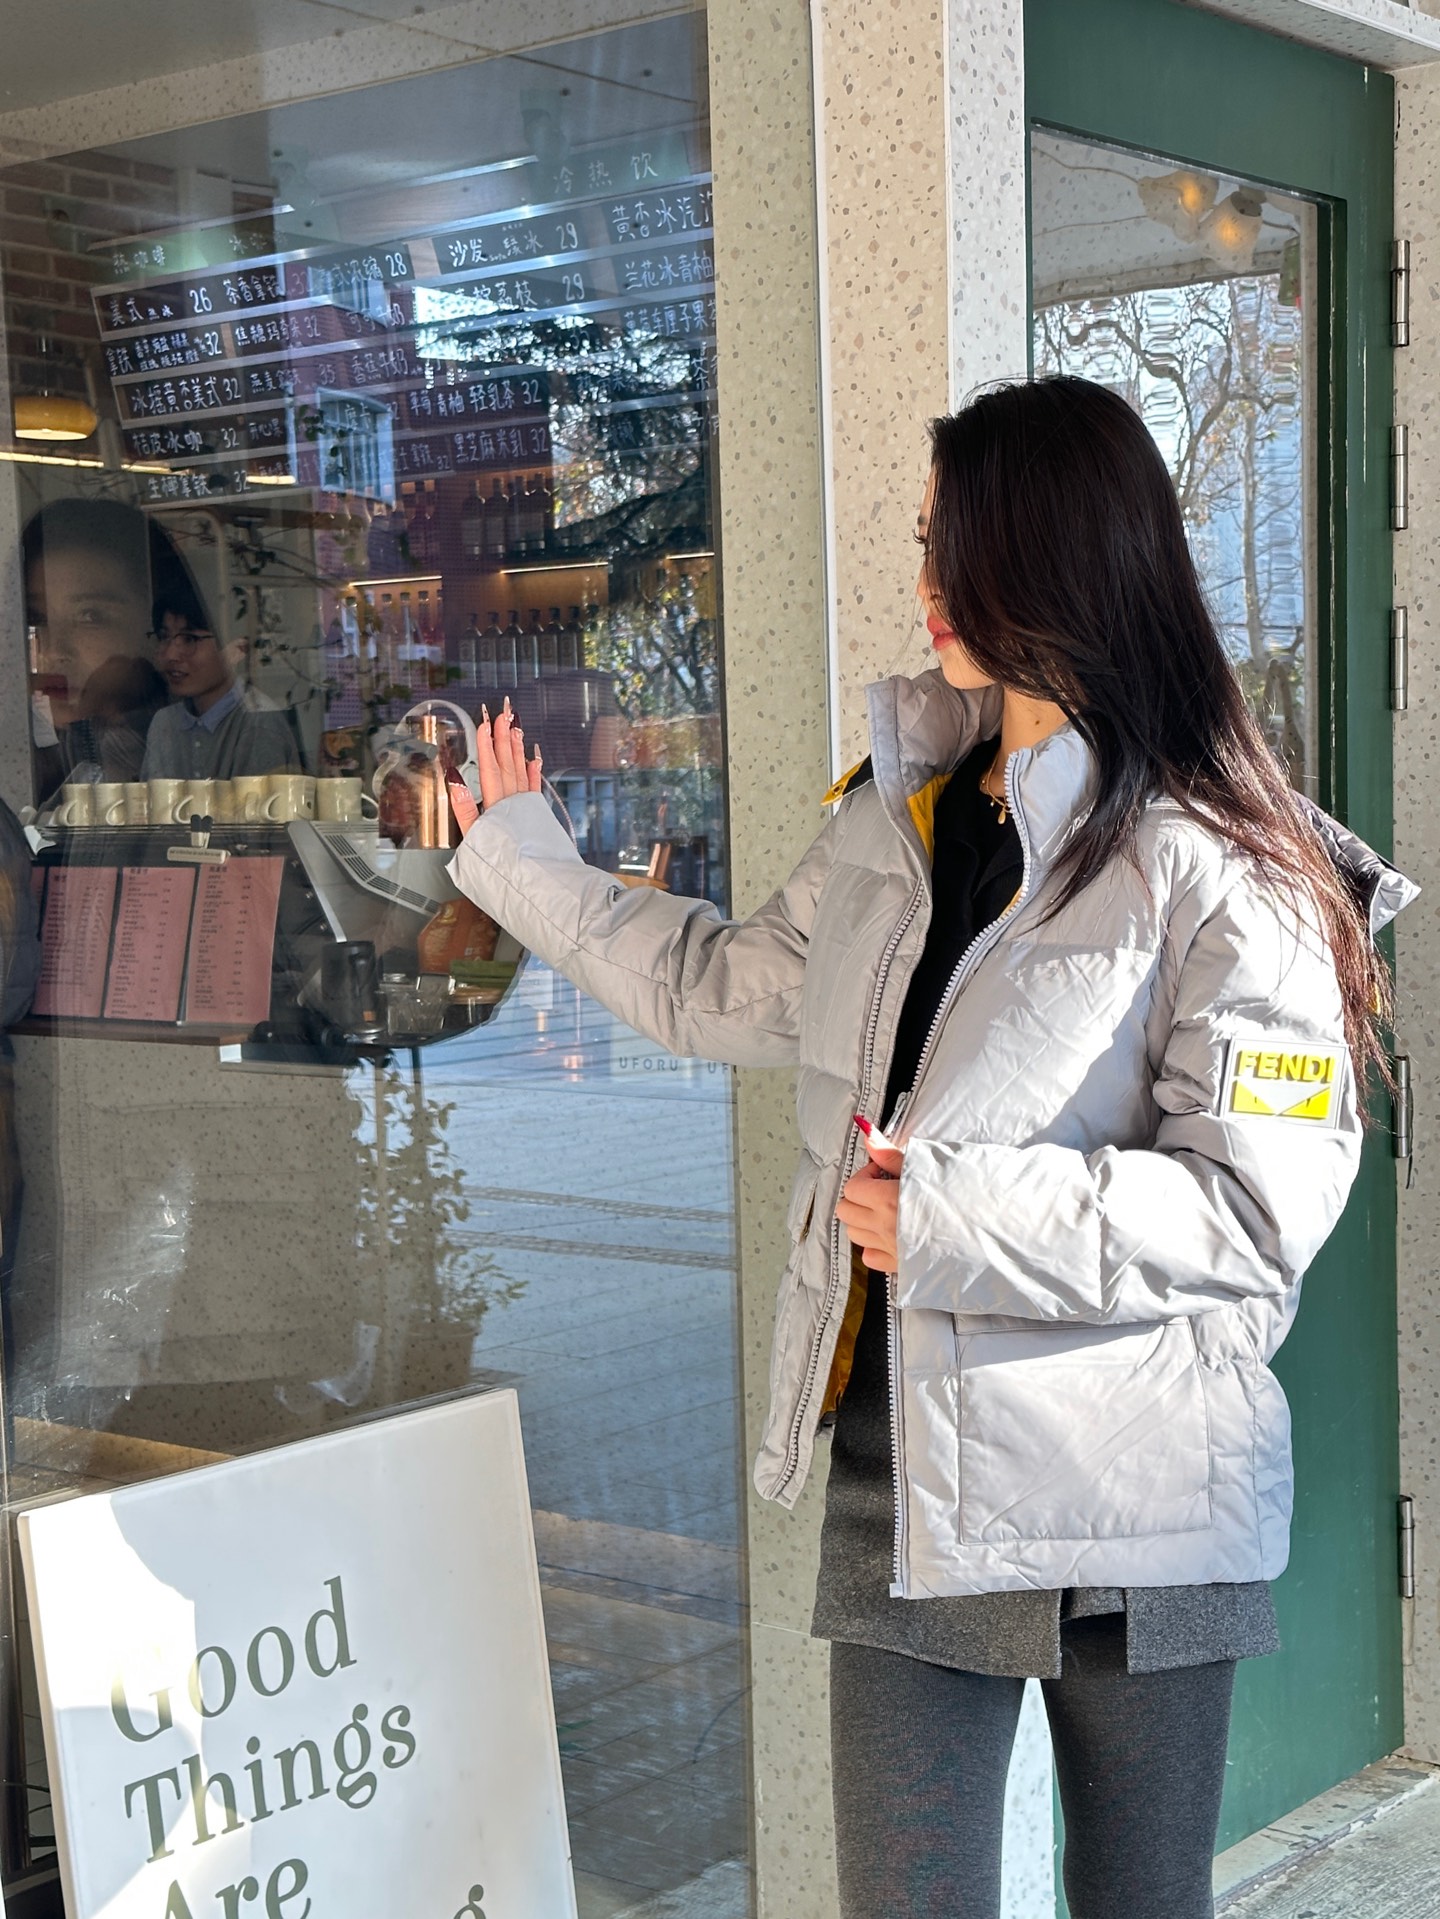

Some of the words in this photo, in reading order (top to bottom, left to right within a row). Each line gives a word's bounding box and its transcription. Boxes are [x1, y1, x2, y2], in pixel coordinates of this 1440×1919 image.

[552, 152, 658, 194] 冷热饮
[448, 238, 488, 267] 沙发
[556, 222, 578, 250] 29
[385, 252, 408, 278] 28
[562, 273, 585, 302] 29
[110, 297, 144, 326] 美式
[189, 287, 212, 314] 26
[304, 315, 321, 339] 32
[204, 331, 223, 356] 32
[222, 376, 242, 402] 32
[521, 379, 543, 406] 32
[220, 427, 241, 448] 32
[529, 427, 549, 454] 32
[233, 469, 252, 493] 32
[618, 1056, 679, 1073] UFORU
[1233, 1049, 1336, 1084] FENDI
[110, 1575, 358, 1742] Good
[123, 1703, 417, 1863] Things
